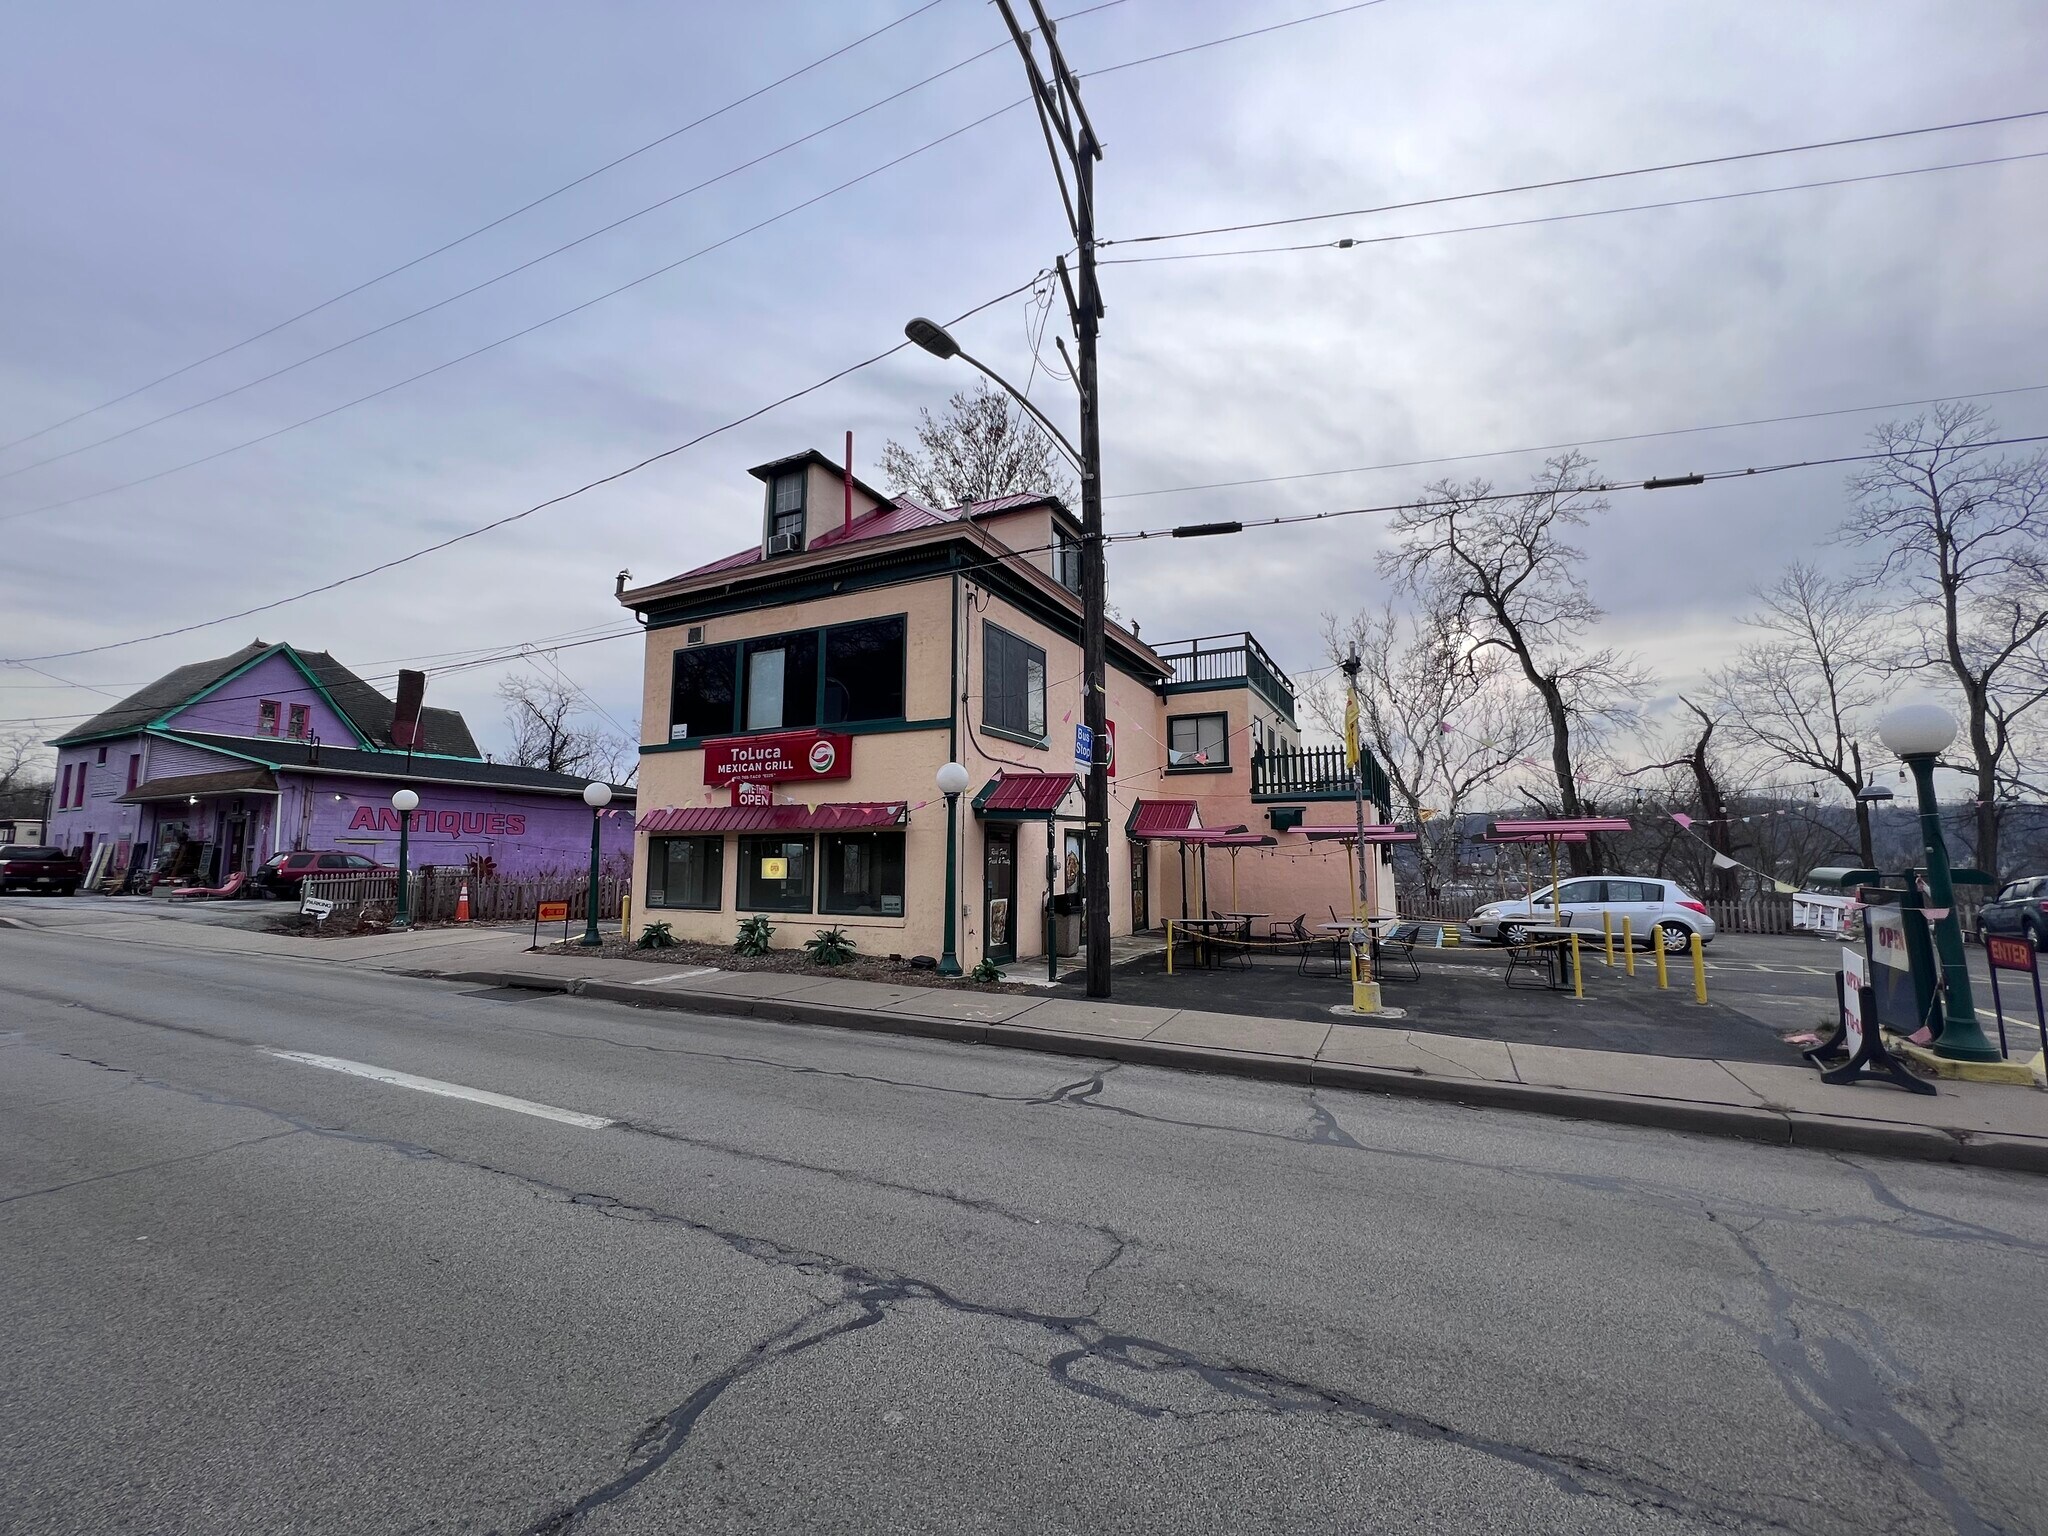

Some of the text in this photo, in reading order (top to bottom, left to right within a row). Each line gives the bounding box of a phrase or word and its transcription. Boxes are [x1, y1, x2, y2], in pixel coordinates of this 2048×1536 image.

[1077, 728, 1090, 742] Bus
[731, 747, 781, 761] ToLuca
[1076, 742, 1091, 759] Stop
[718, 760, 794, 774] MEXICAN GRILL
[739, 794, 769, 806] OPEN
[348, 806, 526, 840] ANTIQUES
[306, 899, 332, 909] PARKING
[1879, 926, 1905, 951] OPEN
[1991, 940, 2028, 965] ENTER
